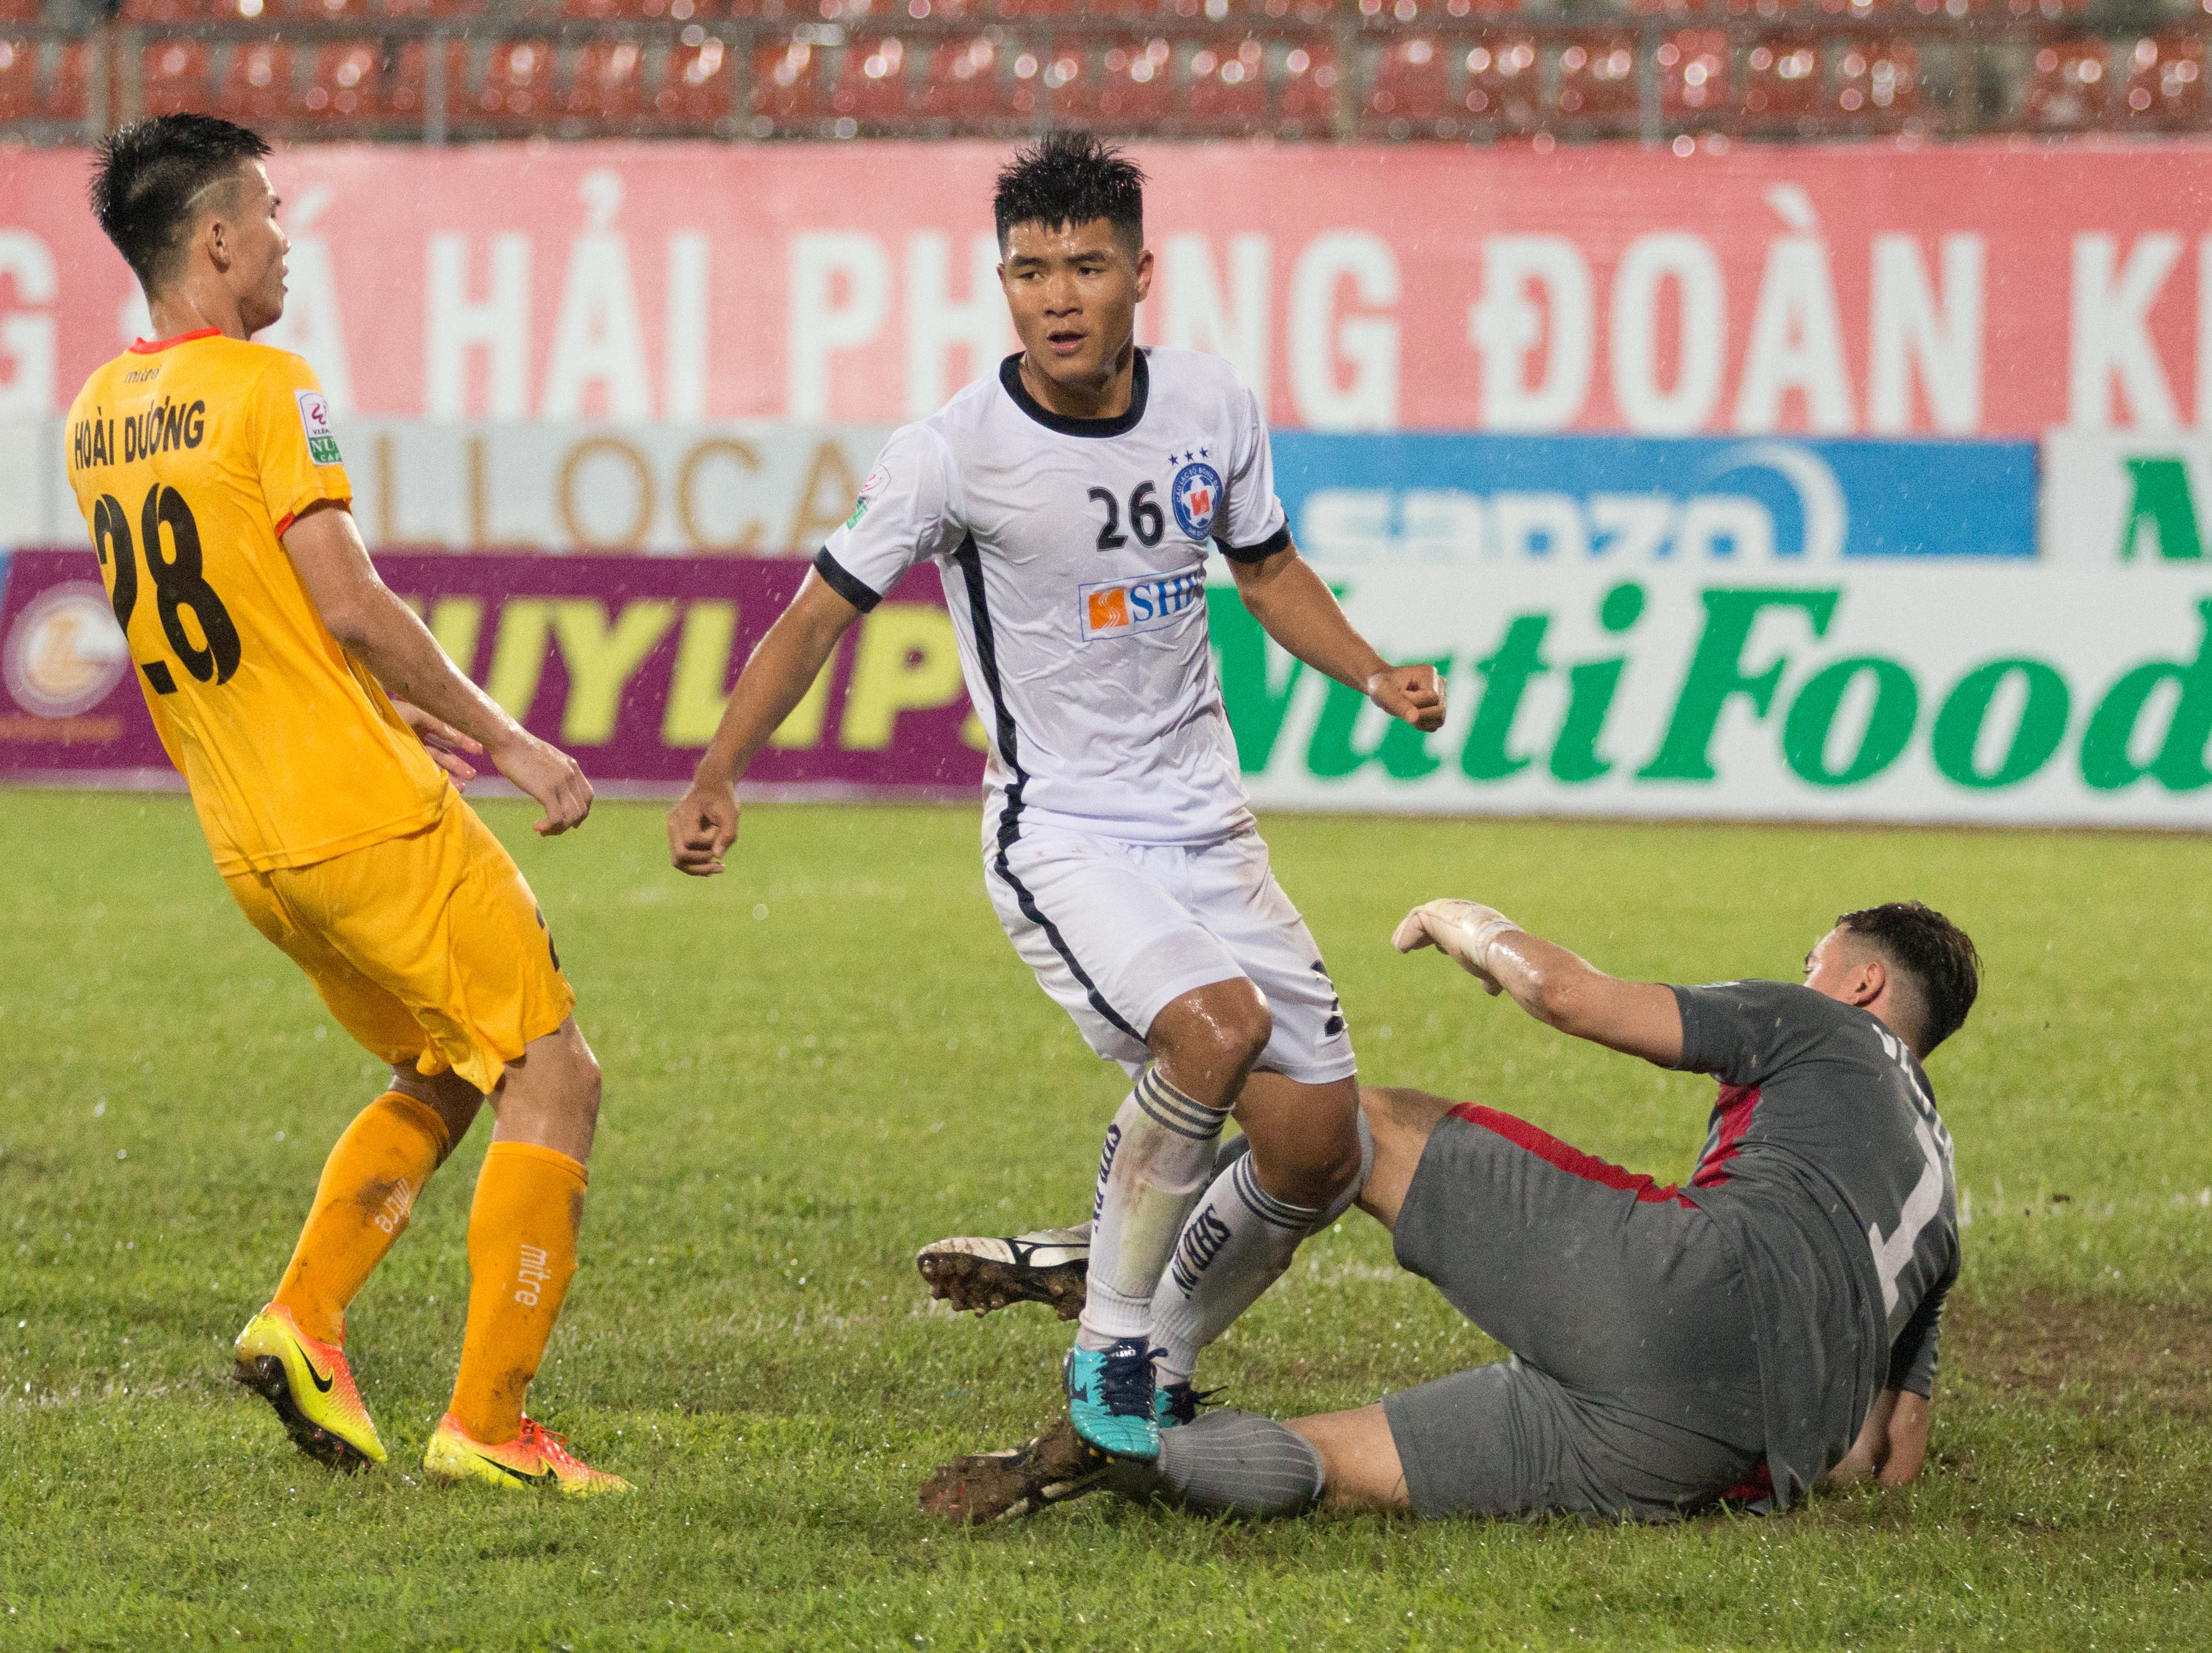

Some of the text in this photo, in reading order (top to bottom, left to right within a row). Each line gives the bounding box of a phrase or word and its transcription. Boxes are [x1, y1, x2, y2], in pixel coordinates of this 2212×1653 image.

[428, 169, 707, 420] HẢI
[1468, 183, 1984, 432] ĐOÀN
[75, 396, 205, 470] HOÀI DƯƠNG
[1087, 480, 1164, 552] 26
[94, 483, 242, 695] 28
[515, 1244, 552, 1307] mitre
